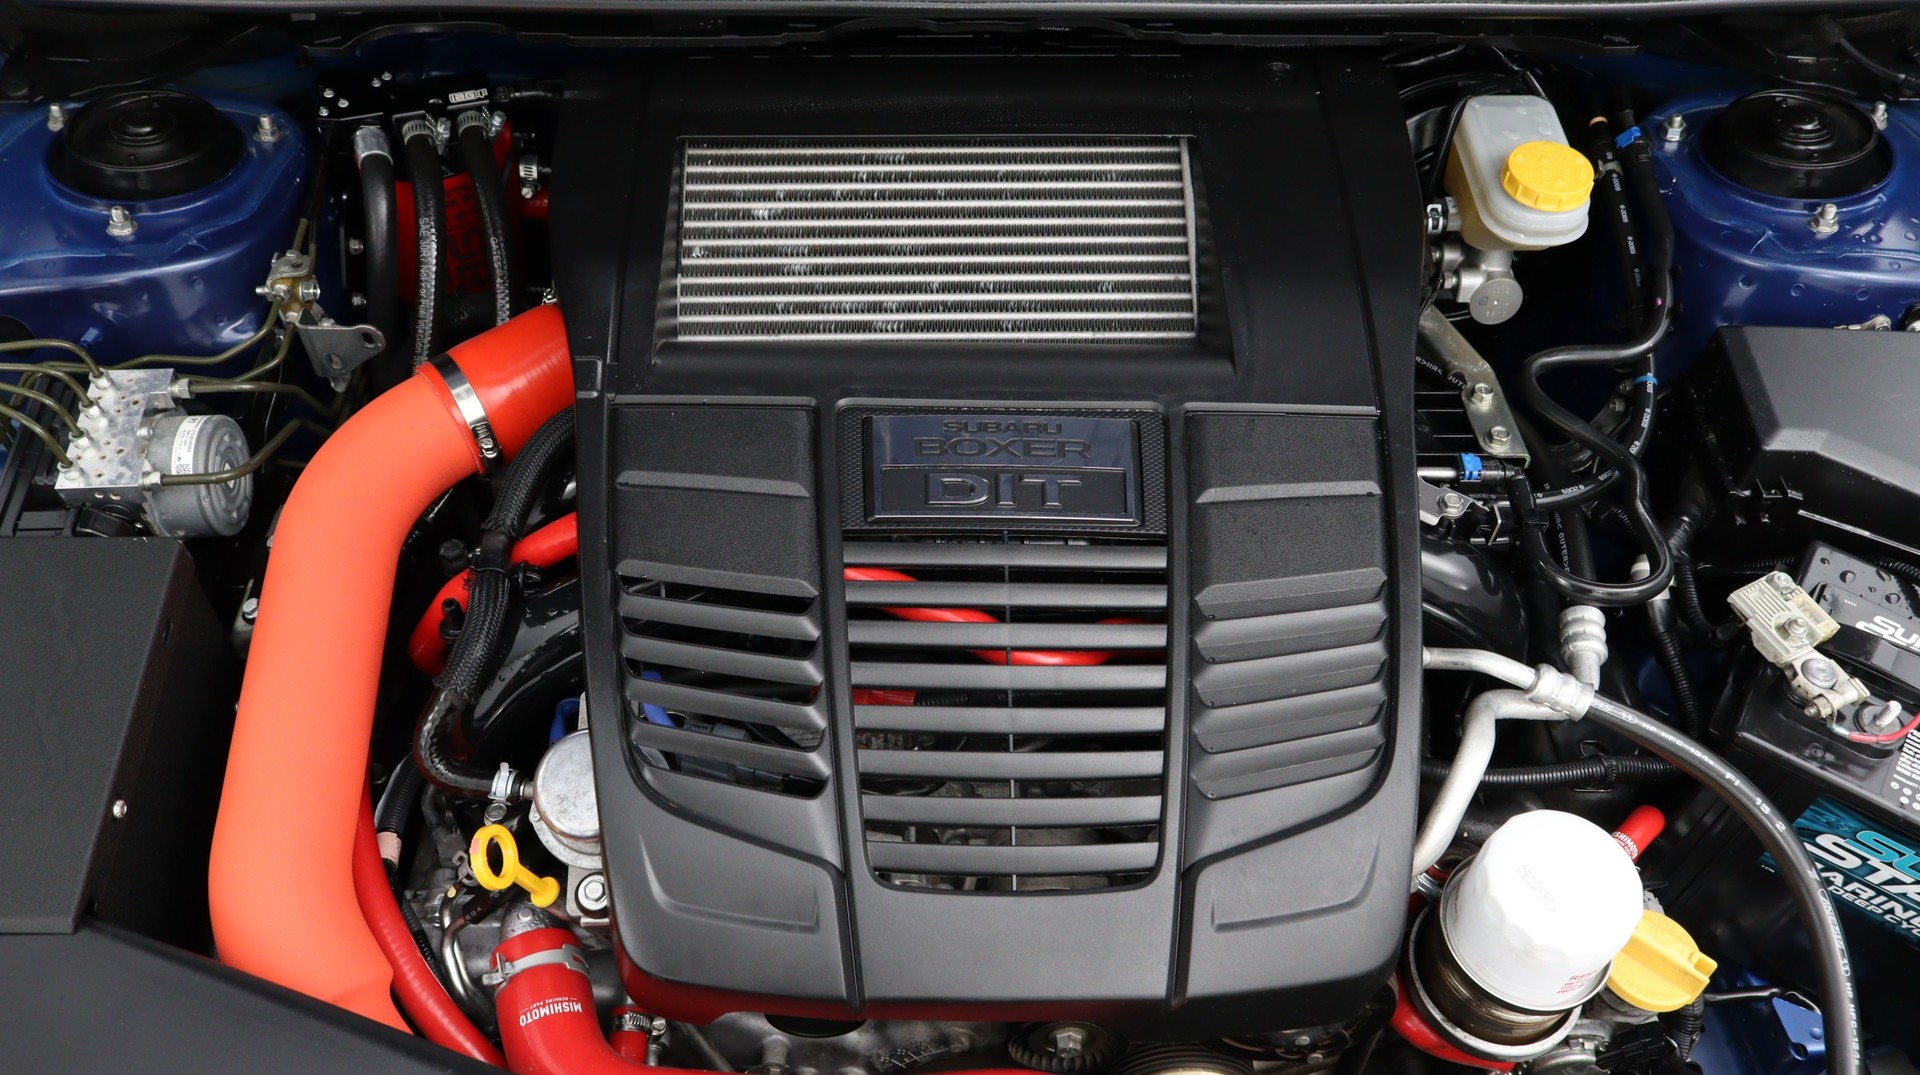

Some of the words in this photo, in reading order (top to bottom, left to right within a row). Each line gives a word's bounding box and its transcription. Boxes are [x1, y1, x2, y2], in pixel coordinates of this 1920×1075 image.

[419, 218, 428, 236] SAE
[942, 420, 1062, 434] SUBARU
[913, 436, 1092, 459] BOXER
[925, 472, 1082, 508] DIT
[1642, 722, 1657, 732] HP
[1755, 797, 1772, 815] 15
[1775, 820, 1786, 832] 2
[1827, 884, 1884, 914] DEEP
[1845, 982, 1853, 998] HP
[520, 1003, 582, 1026] MISHIMOTO
